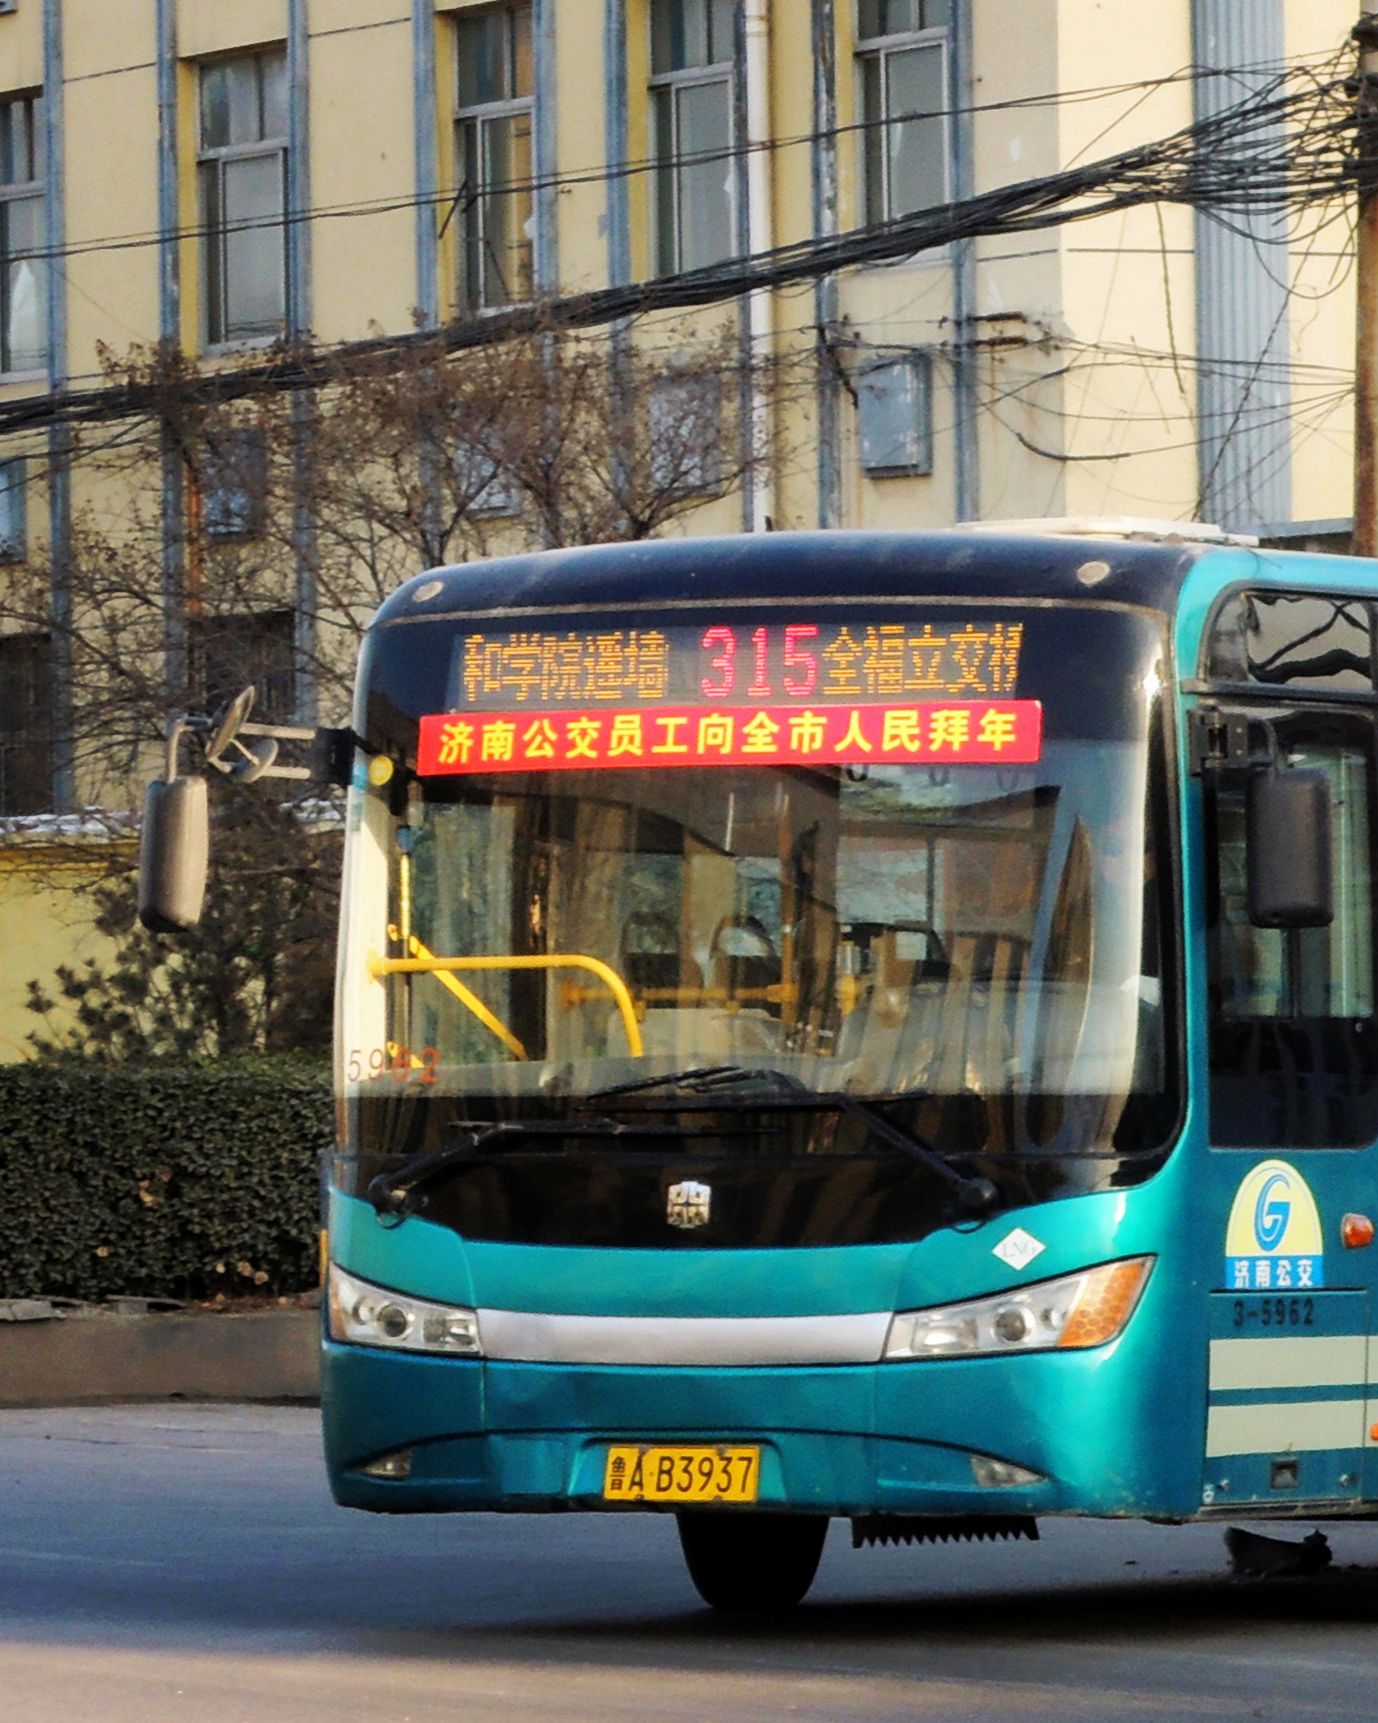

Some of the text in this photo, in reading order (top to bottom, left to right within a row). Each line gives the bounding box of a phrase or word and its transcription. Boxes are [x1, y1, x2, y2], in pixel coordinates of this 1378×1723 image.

[701, 625, 819, 698] 315
[438, 708, 1018, 764] 济南公交员工向全市人民拜年
[1234, 1259, 1313, 1288] 济南公交
[1233, 1299, 1315, 1326] 3-5962
